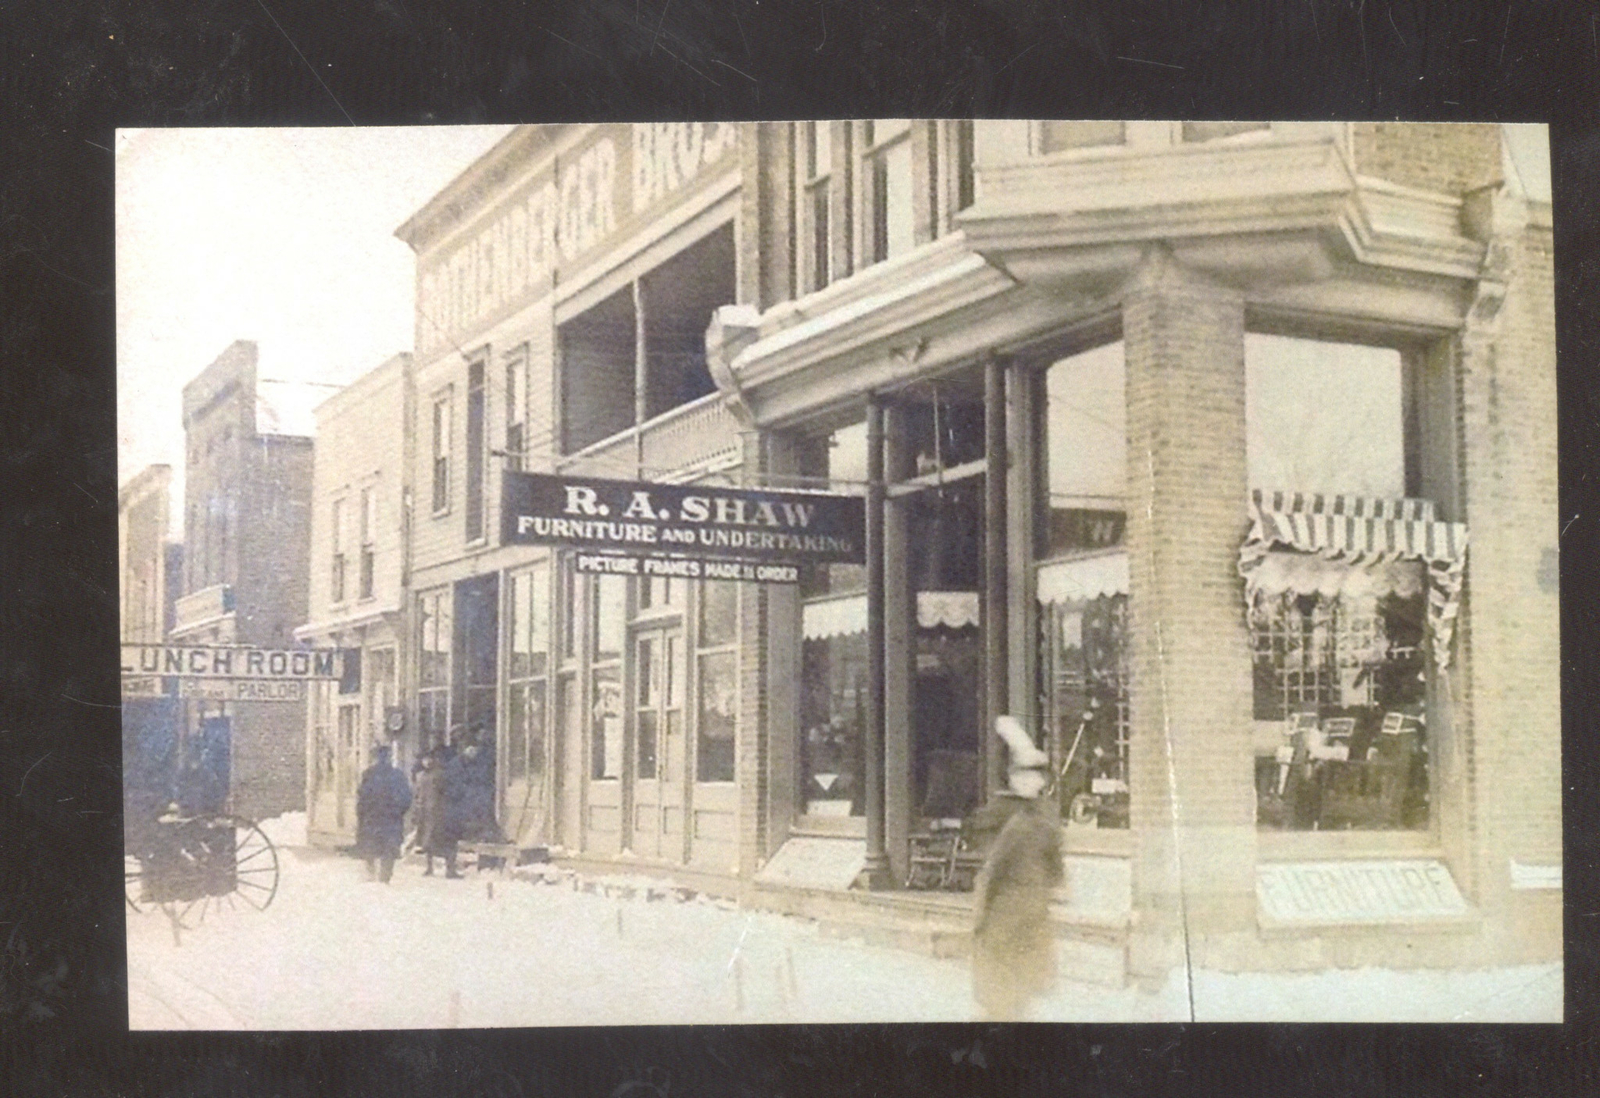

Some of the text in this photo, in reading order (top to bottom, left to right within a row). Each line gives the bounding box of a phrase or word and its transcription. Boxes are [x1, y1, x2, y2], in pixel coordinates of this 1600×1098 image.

[564, 486, 813, 528] R. A. SHAW
[517, 515, 852, 553] FURNITURE AND UNDERTAKING
[577, 556, 638, 575] PICTURE
[643, 559, 700, 577] FRAMES
[757, 566, 798, 582] ORDER
[246, 652, 333, 676] ROOM
[238, 680, 299, 699] PARLOR
